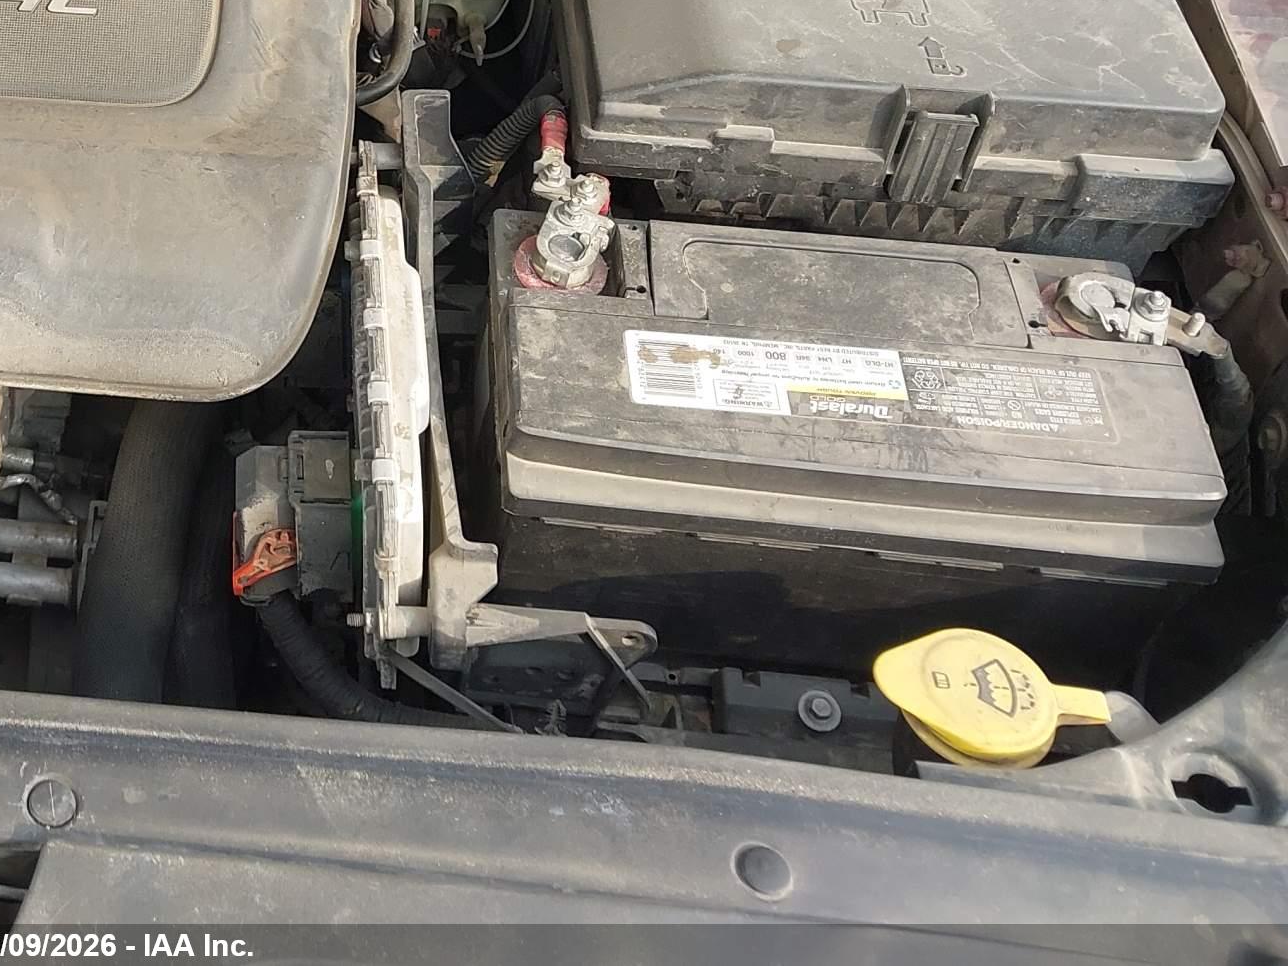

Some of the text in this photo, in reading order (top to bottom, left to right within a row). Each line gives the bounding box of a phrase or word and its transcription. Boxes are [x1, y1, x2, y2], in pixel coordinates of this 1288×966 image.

[736, 349, 755, 357] 1000
[764, 350, 787, 361] 800
[840, 348, 879, 356] DISTRIBUTED
[780, 373, 810, 381] AutoZone
[808, 394, 846, 403] GOLD
[808, 399, 894, 419] Duralast
[955, 415, 1050, 431] DANGER/POISON
